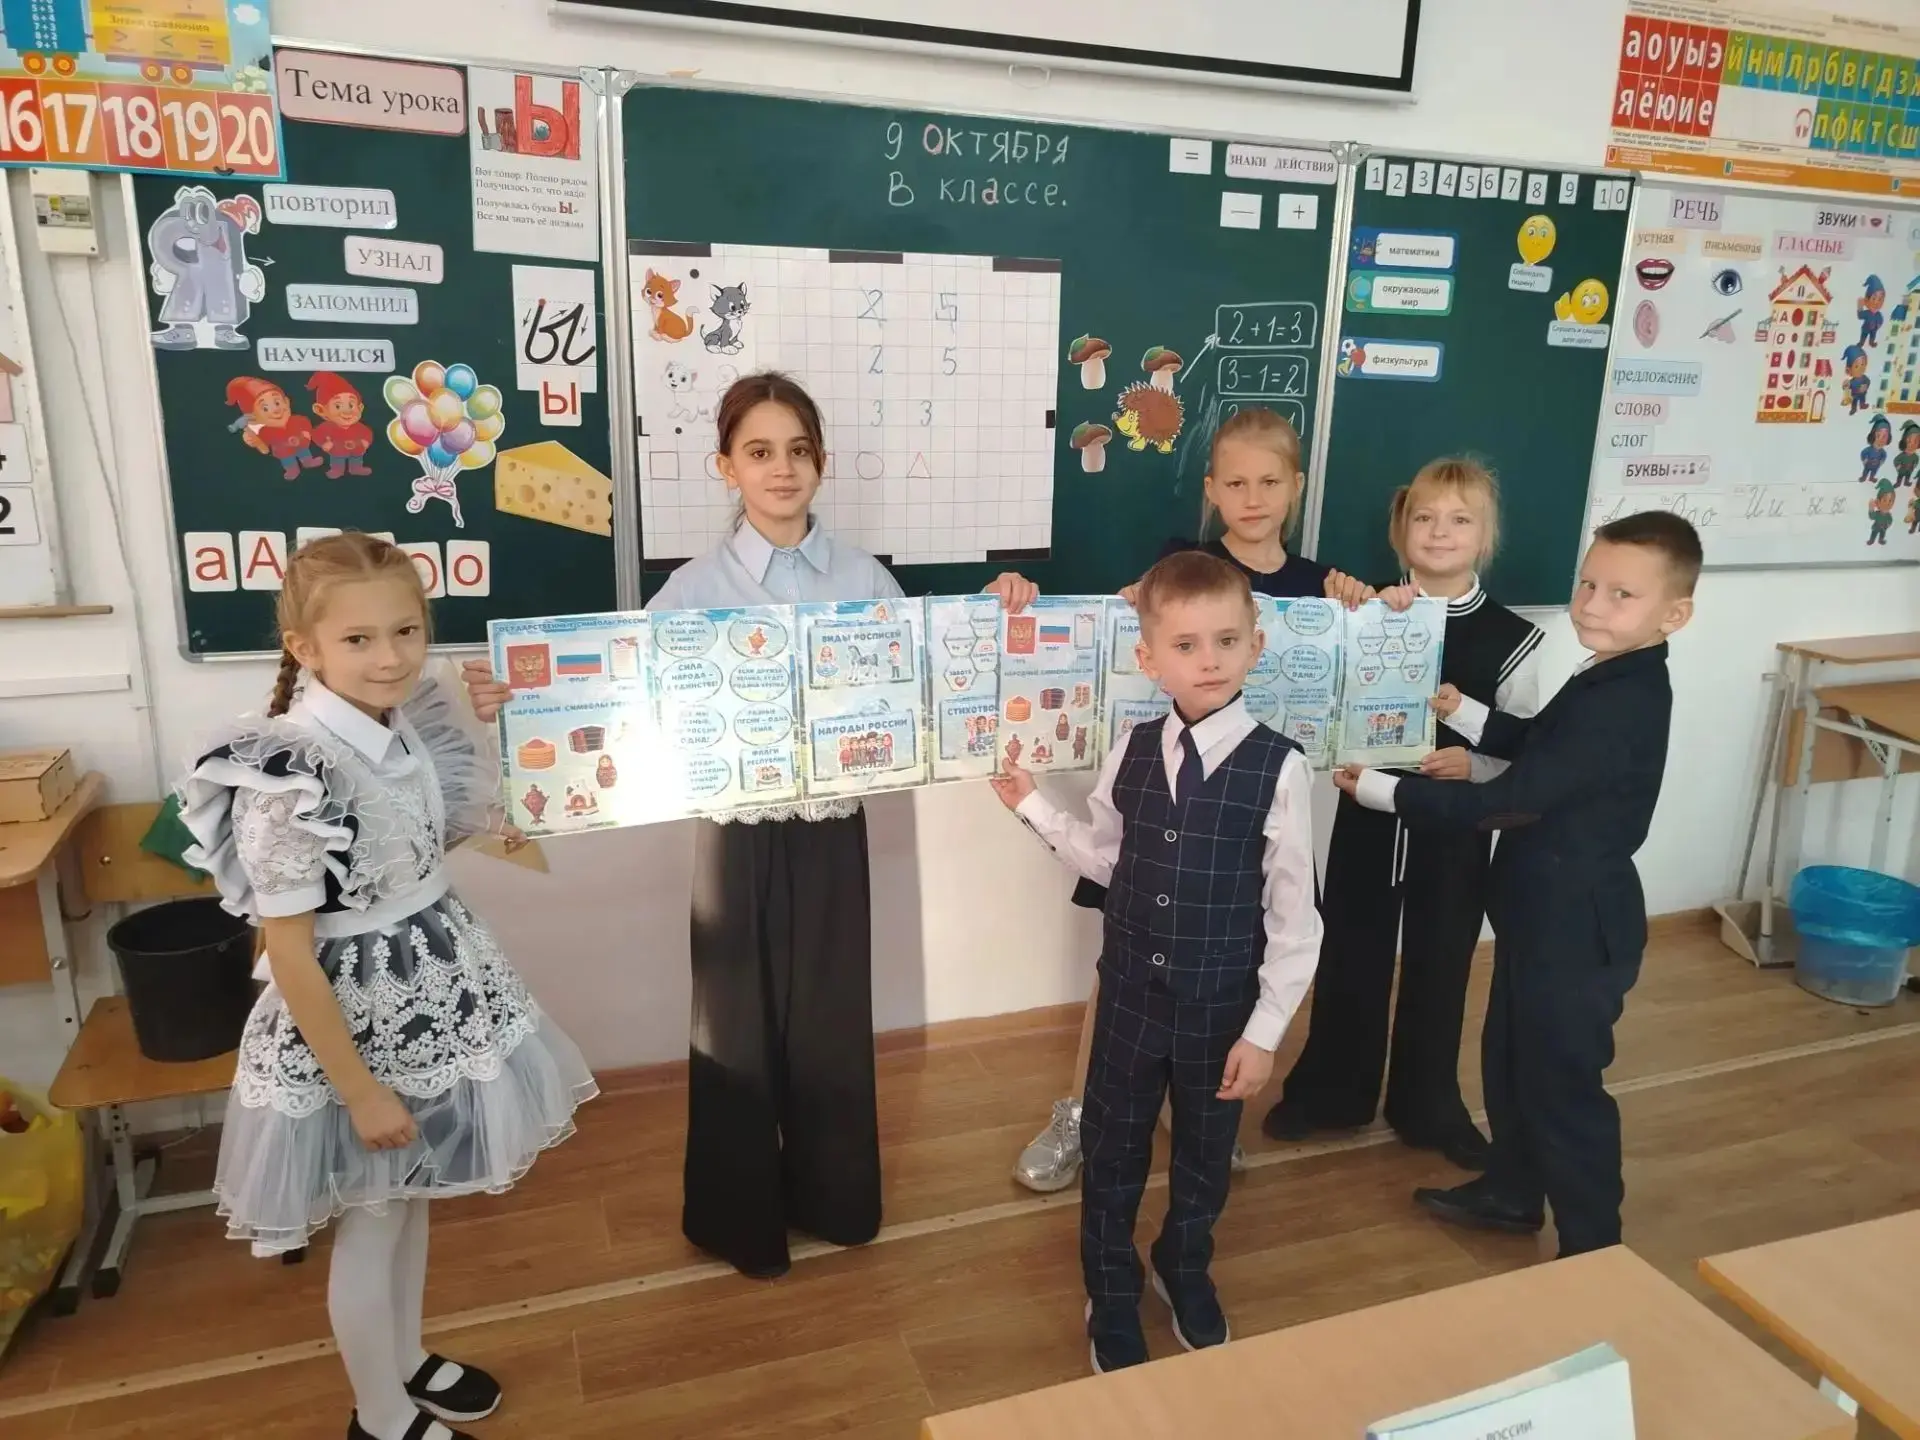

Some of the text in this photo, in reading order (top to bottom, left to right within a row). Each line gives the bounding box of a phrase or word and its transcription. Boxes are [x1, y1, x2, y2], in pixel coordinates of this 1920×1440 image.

[285, 68, 460, 115] Тема урока
[42, 92, 97, 154] 17
[102, 95, 162, 159] 18
[162, 100, 218, 162] 19
[221, 104, 275, 166] 20
[884, 121, 902, 161] 9
[1228, 153, 1335, 174] ЗНАКИ ДЕЙСТВИЯ
[476, 179, 530, 193] Получилось
[888, 171, 1068, 207] В классе.
[1371, 167, 1381, 184] 1
[1392, 172, 1404, 190] 2
[1418, 170, 1429, 188] 3
[1442, 173, 1454, 190] 4
[1465, 175, 1476, 192] 5
[1483, 173, 1494, 191] 6
[1508, 177, 1519, 194] 7
[1531, 181, 1543, 199] 8
[1564, 180, 1575, 198] 9
[477, 210, 494, 221] Все
[495, 214, 509, 222] мы
[1671, 198, 1720, 222] РЕЧЬ
[1816, 210, 1858, 229] ЗВУКИ
[1636, 231, 1676, 247] устная
[1777, 235, 1846, 255] ГЛАСНЫЕ
[356, 246, 433, 273] УЗНАЛ
[1388, 246, 1441, 258] математика
[1382, 283, 1440, 297] окружающий
[290, 292, 409, 314] ЗАПОМНИЛ
[1400, 298, 1419, 308] мир
[263, 345, 387, 366] НАУЧИЛСЯ
[1372, 353, 1430, 368] физкультура
[1626, 462, 1670, 478] БУКВЫ
[194, 544, 229, 582] а
[245, 535, 287, 580] А
[822, 633, 851, 643] ВИДЫ
[1120, 625, 1142, 633] НАР
[564, 701, 609, 712] СИМВОЛЫ
[817, 718, 908, 736] НАРОДЫ РОССИИ
